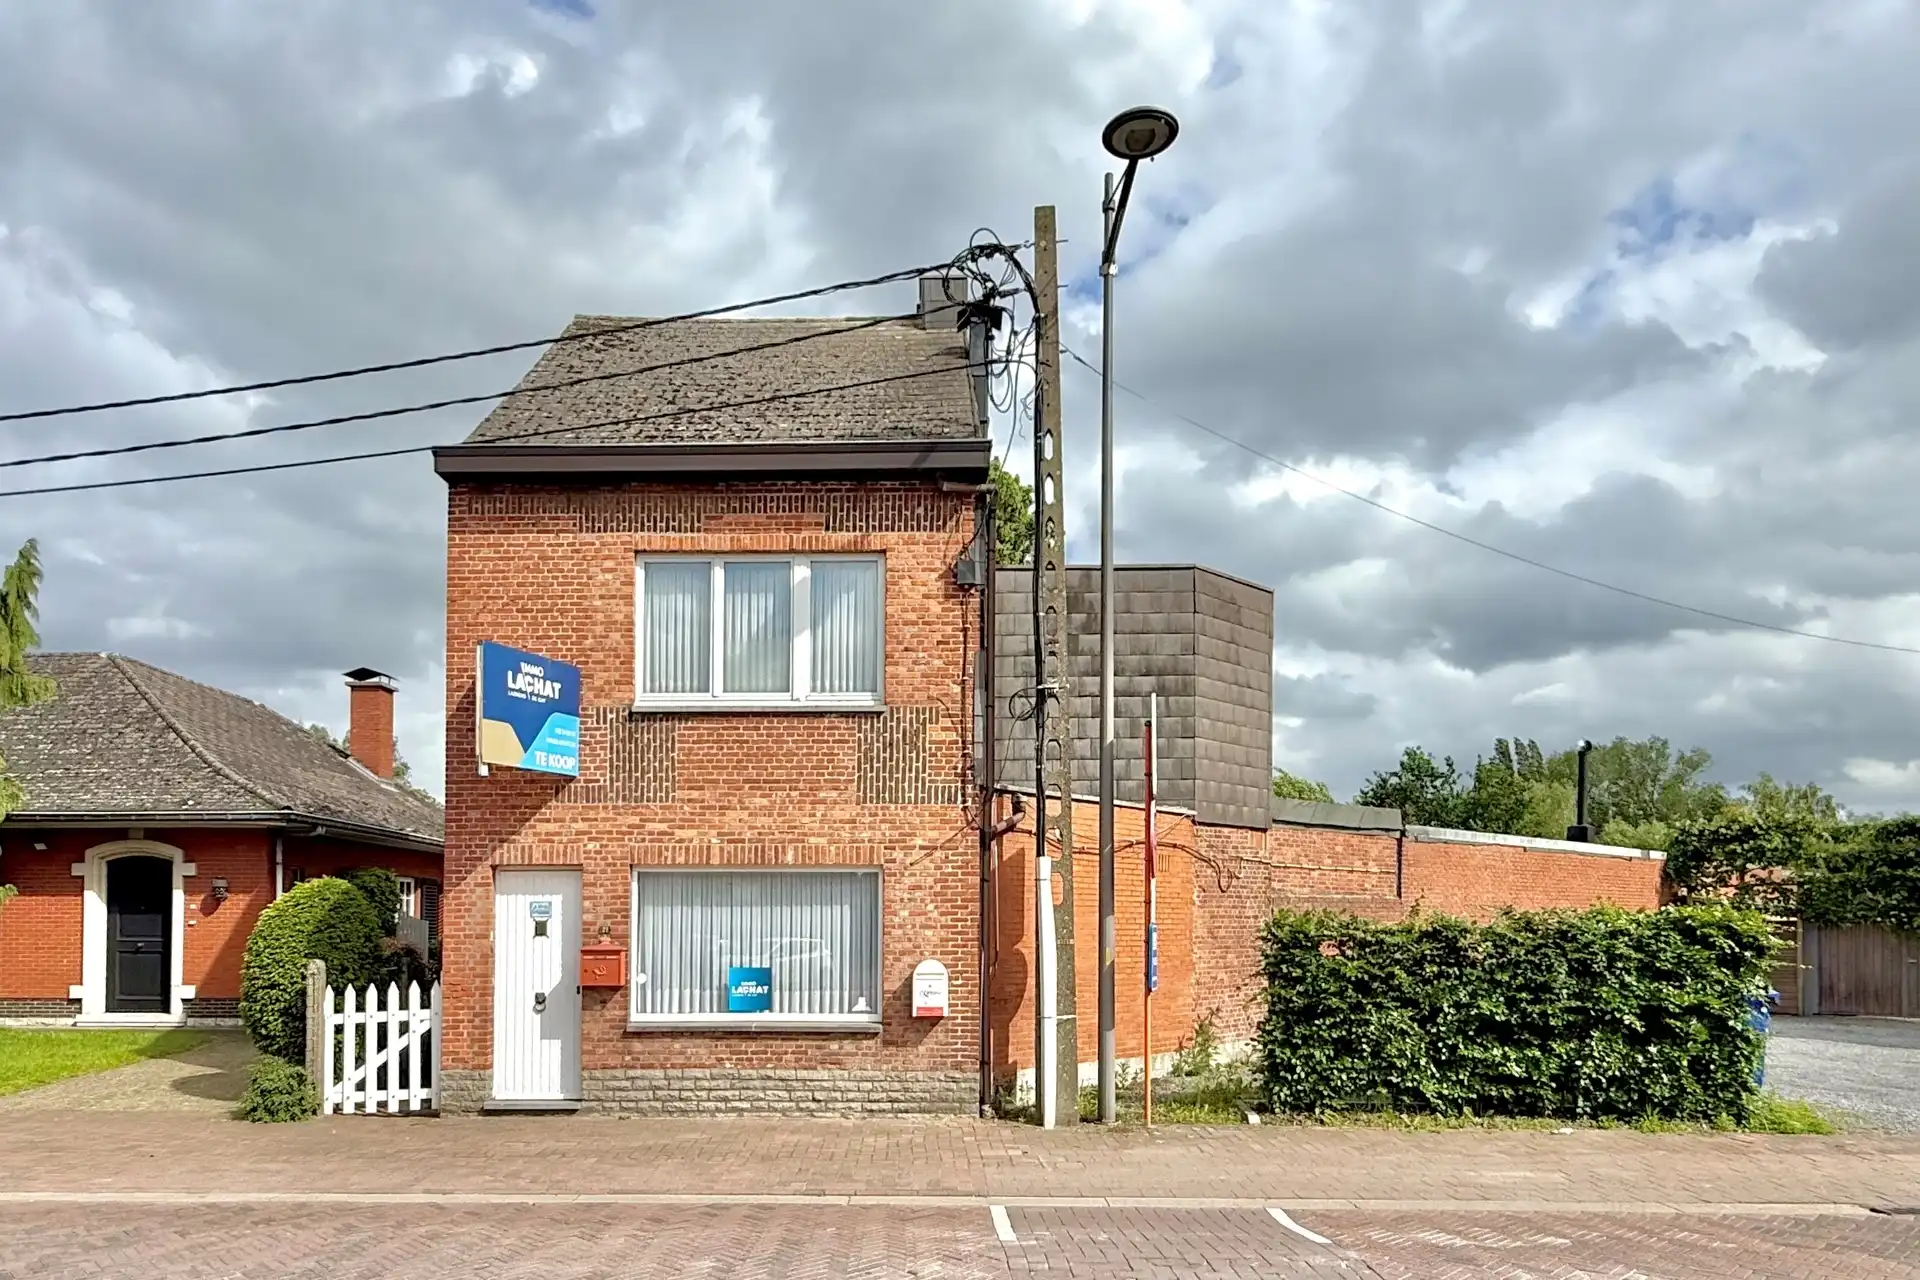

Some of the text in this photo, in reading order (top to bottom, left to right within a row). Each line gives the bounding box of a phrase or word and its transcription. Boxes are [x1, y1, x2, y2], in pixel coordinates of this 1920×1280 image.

[520, 661, 544, 677] IMMO
[507, 670, 561, 700] LACHAT
[535, 750, 576, 770] TE KOOP
[731, 985, 769, 994] LACHAT
